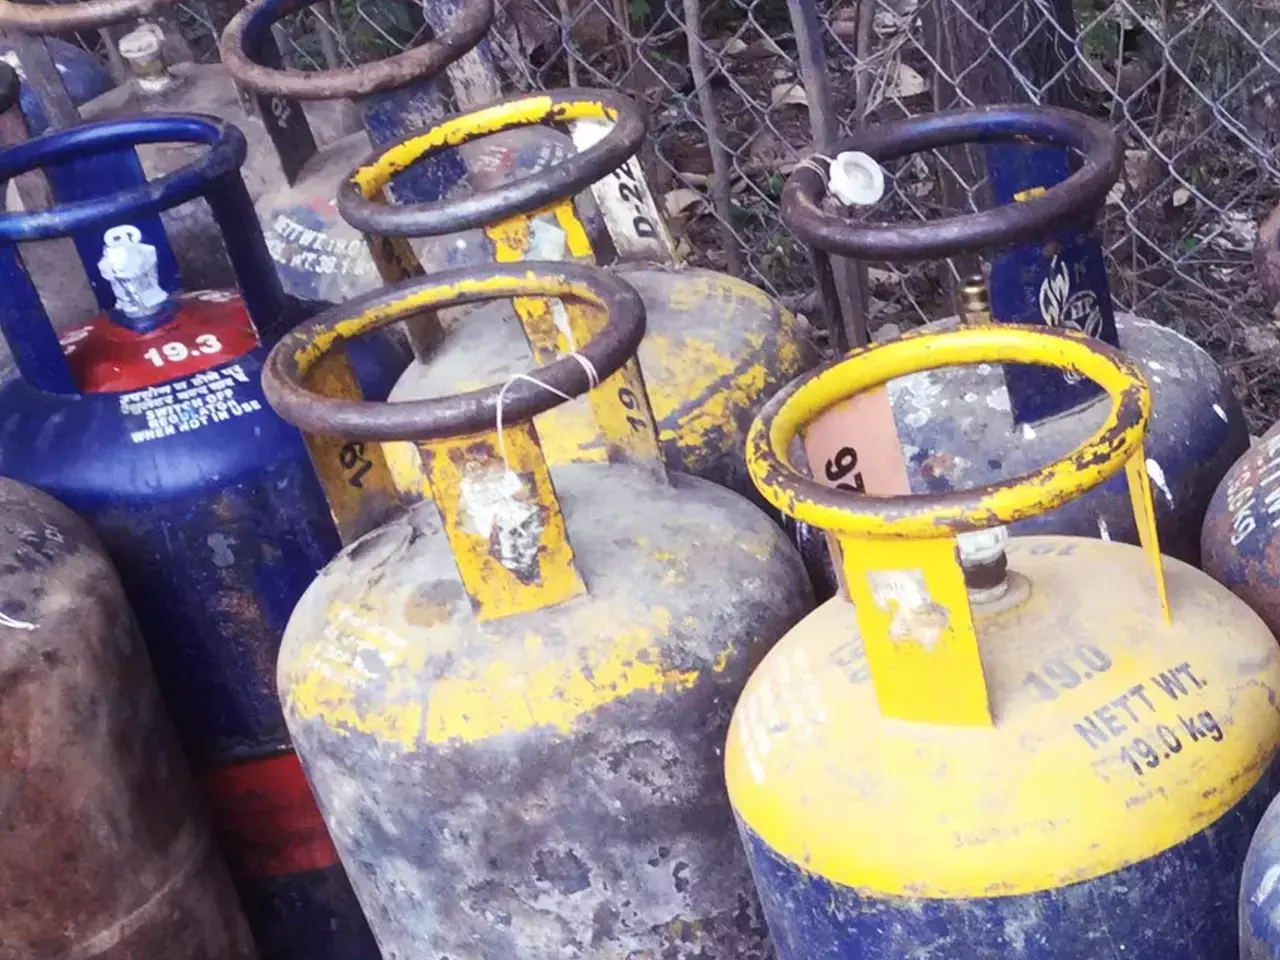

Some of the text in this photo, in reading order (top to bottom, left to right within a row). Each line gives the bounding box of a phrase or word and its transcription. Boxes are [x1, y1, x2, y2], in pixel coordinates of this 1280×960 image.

[144, 334, 222, 368] 19.3
[1022, 642, 1112, 701] 19.0
[1073, 661, 1208, 750] NETT WT.
[1119, 710, 1224, 776] 19.0 kg
